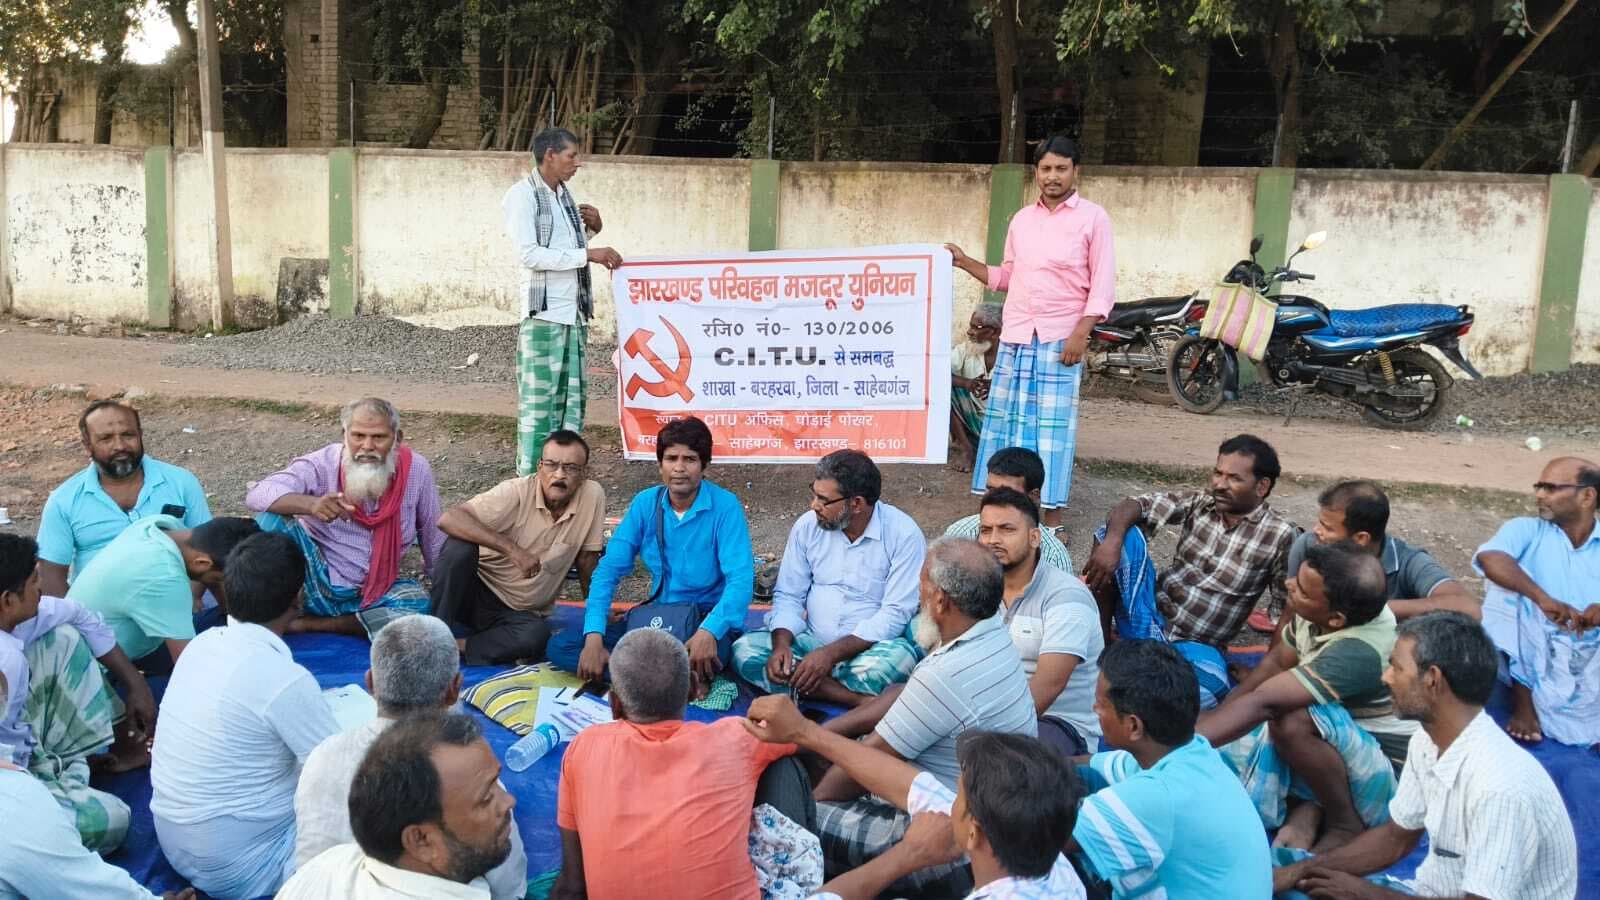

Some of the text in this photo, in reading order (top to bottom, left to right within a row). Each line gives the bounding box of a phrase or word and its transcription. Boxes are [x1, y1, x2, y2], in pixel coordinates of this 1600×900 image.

[628, 263, 916, 311] झारखण्ड परिवहन मजदूर युनियन
[804, 321, 894, 336] 130/2006
[714, 347, 895, 368] C.I.T.U. से समबद्ध
[702, 380, 736, 398] शाखा
[751, 379, 801, 399] बरहरवा,
[806, 376, 838, 398] जिला
[854, 377, 910, 399] साहेबगंज
[705, 414, 736, 426] CITU
[864, 438, 906, 450] 816101
